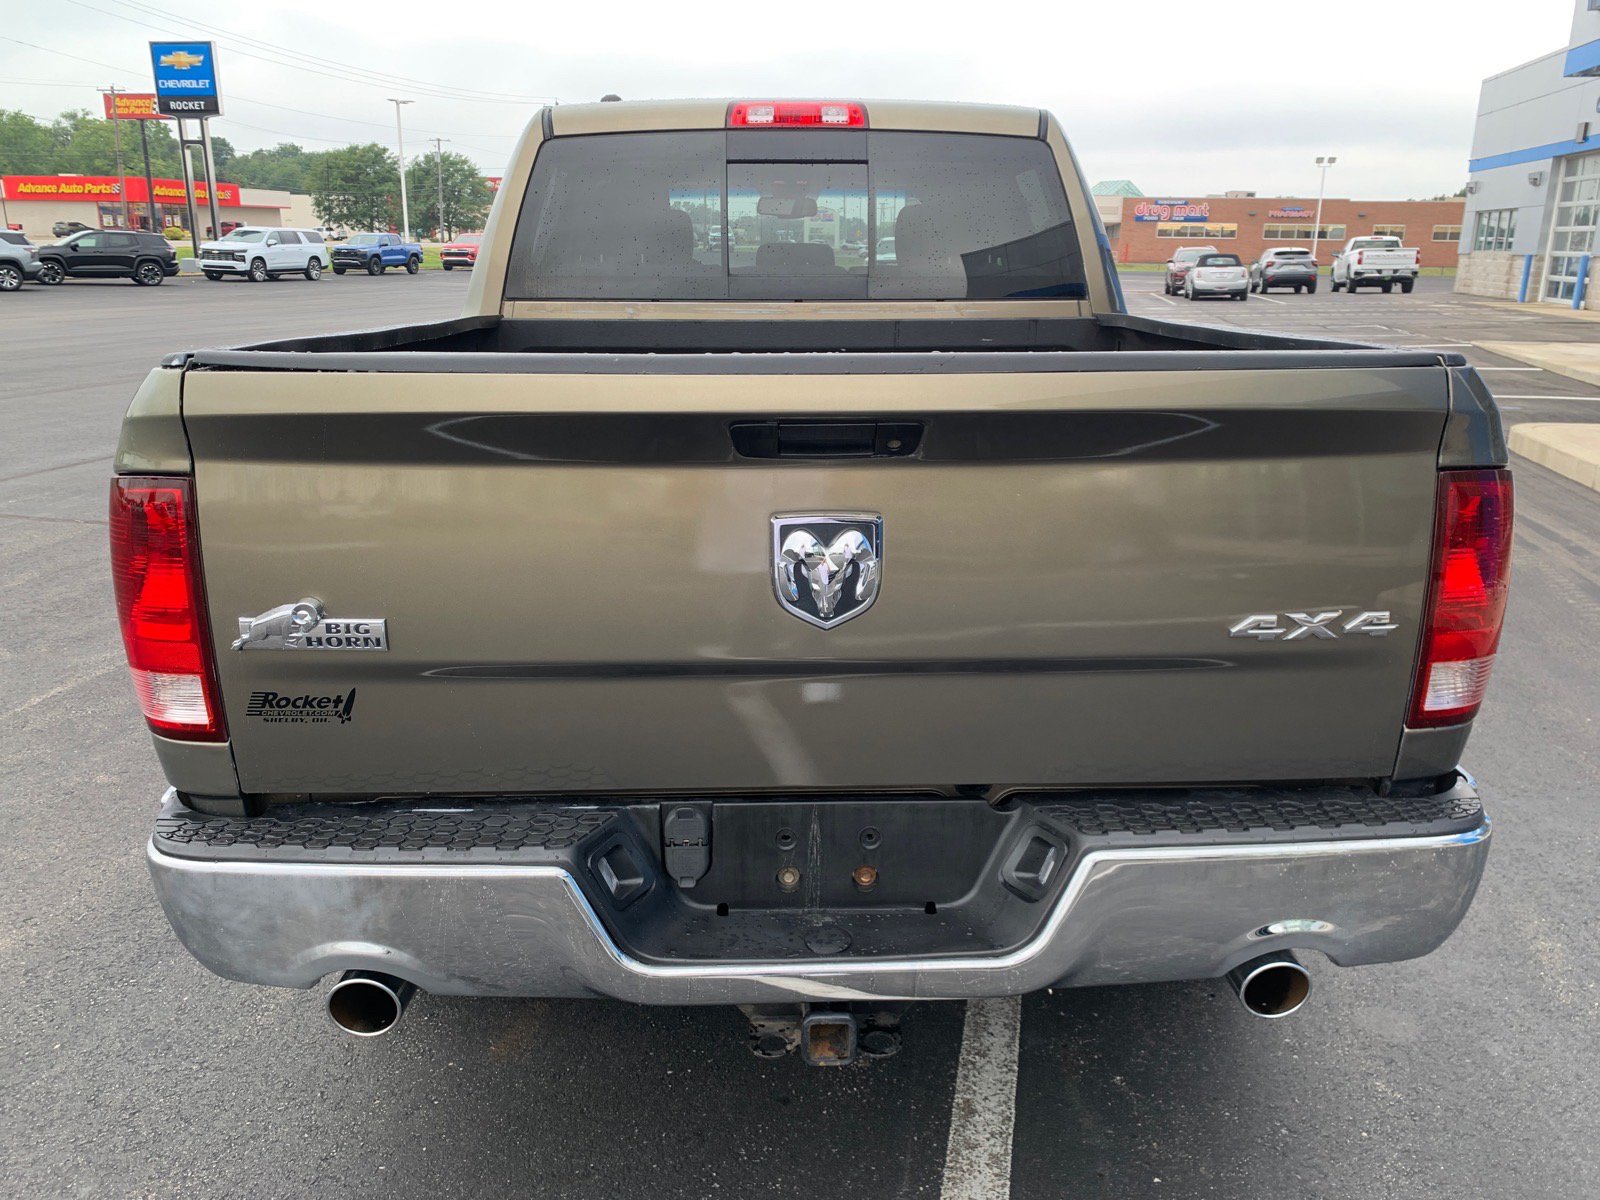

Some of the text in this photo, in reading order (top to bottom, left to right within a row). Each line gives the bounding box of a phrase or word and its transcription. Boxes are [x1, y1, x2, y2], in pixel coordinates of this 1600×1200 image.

[158, 79, 210, 89] CHEVROLET
[169, 101, 205, 110] ROCKET
[17, 183, 111, 193] Advance Auto Parts
[1135, 202, 1210, 221] drug mart
[325, 622, 371, 636] BIG
[305, 636, 382, 649] HORN
[259, 692, 344, 709] Rocket
[261, 709, 337, 717] CHEVROLET.COM
